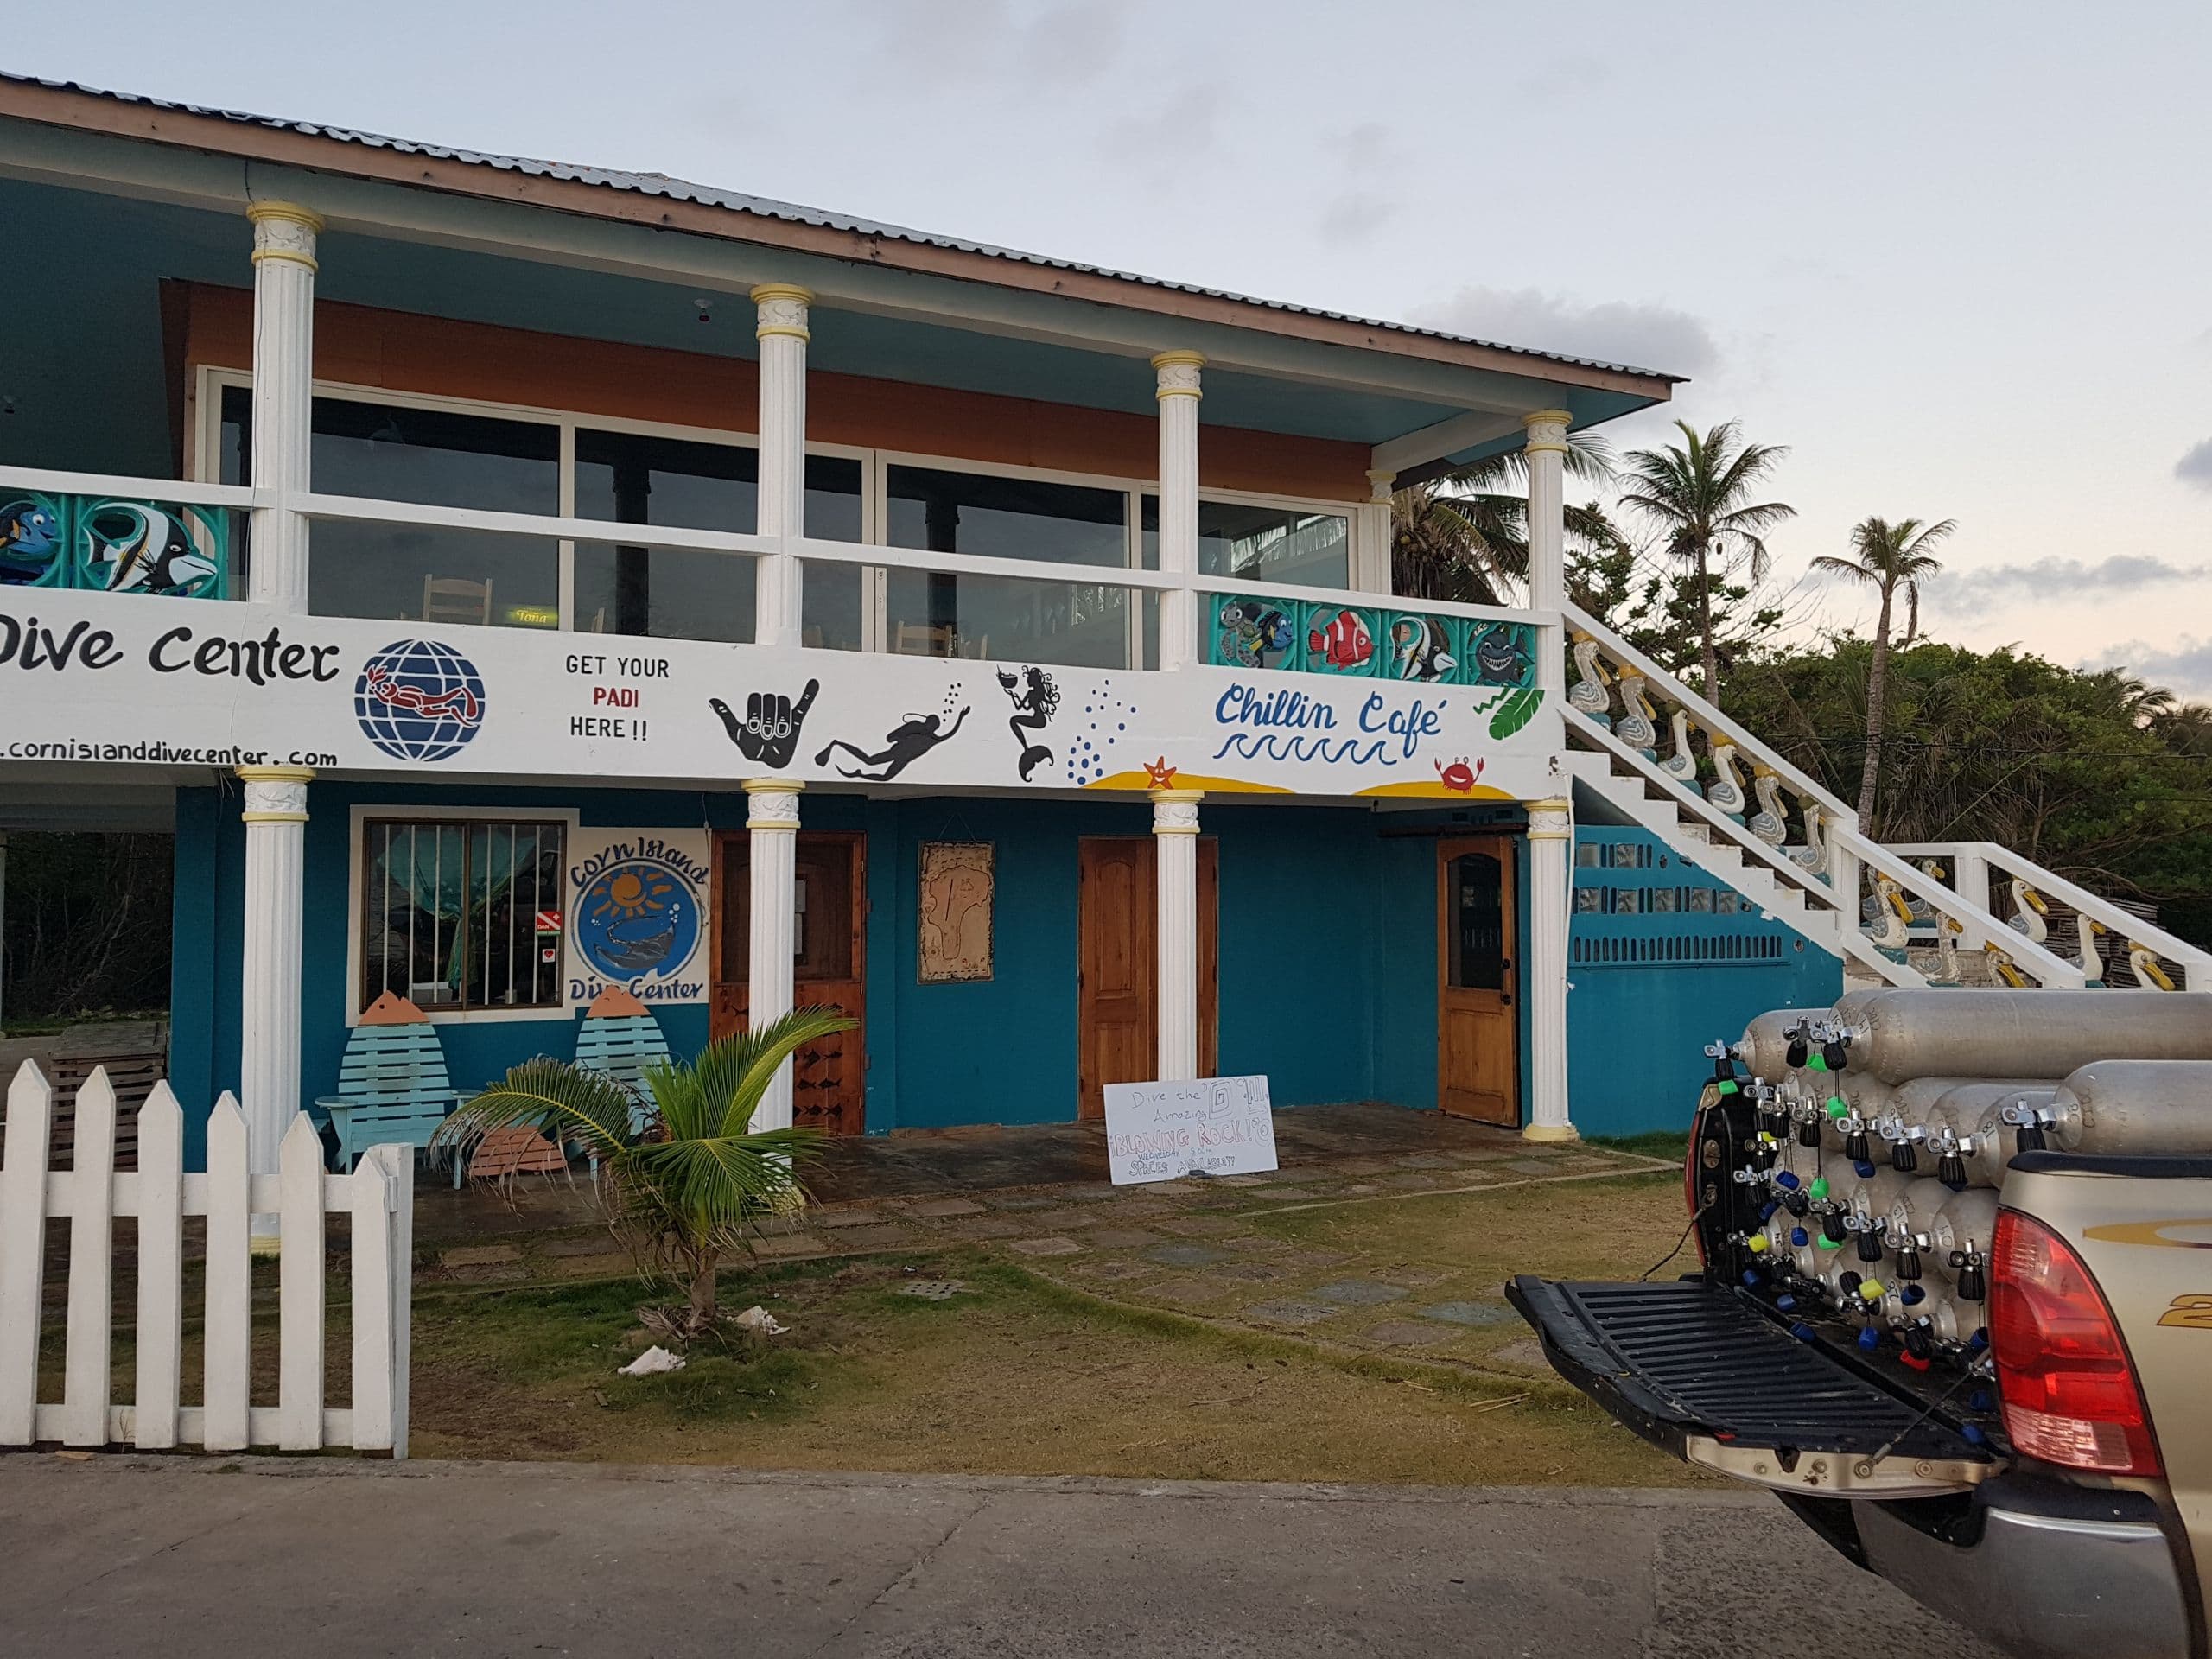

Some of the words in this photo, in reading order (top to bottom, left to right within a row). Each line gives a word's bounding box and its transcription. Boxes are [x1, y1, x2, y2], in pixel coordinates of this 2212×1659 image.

[516, 608, 548, 623] Toña
[149, 627, 340, 686] Center
[566, 654, 607, 674] GET
[617, 657, 670, 678] YOUR
[593, 686, 639, 708] PADI
[1215, 682, 1338, 729] Chillin
[1358, 691, 1448, 760] Café
[570, 842, 635, 887] Corn
[638, 836, 709, 884] Island
[569, 976, 620, 1000] Div
[629, 978, 703, 999] Center
[1132, 1091, 1166, 1109] Dive
[1176, 1088, 1201, 1100] the
[1154, 1109, 1207, 1123] Amazing
[1128, 1160, 1169, 1176] SPACES
